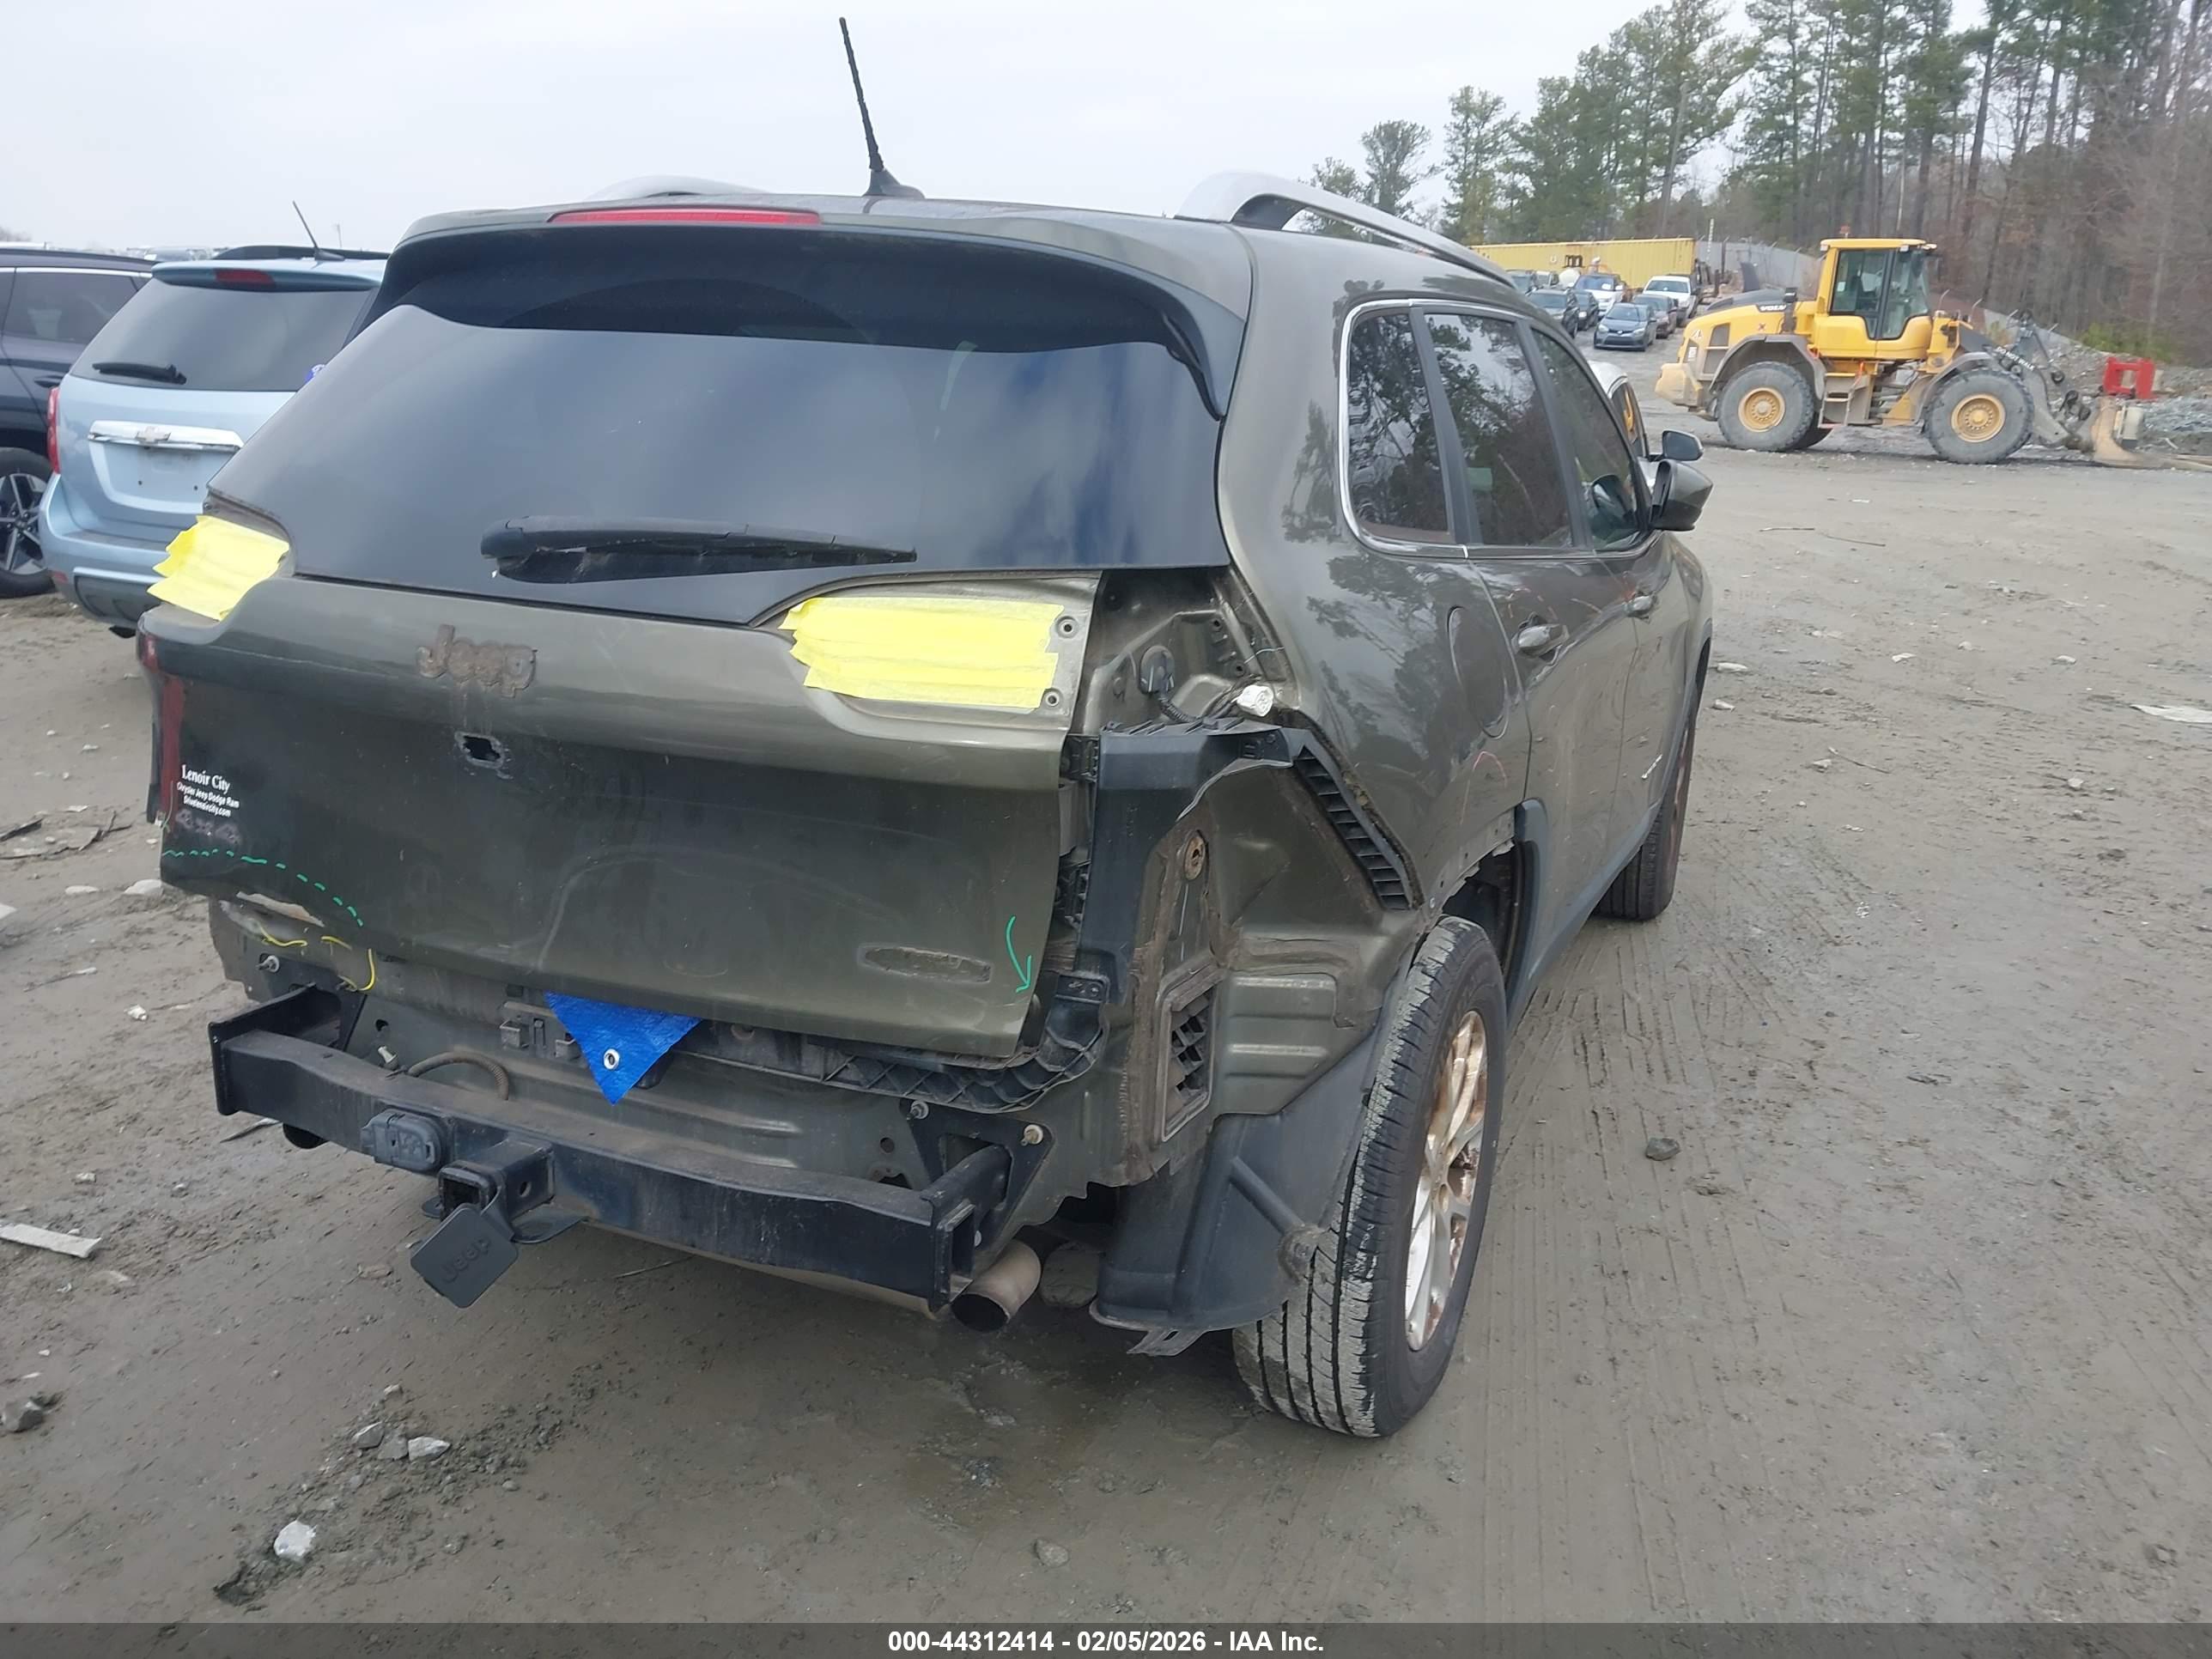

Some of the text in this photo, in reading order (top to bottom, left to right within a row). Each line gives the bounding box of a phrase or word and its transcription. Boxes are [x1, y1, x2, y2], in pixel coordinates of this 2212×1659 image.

[2006, 351, 2020, 362] NOT
[2019, 358, 2035, 371] WALK
[181, 764, 231, 794] Lenoir City
